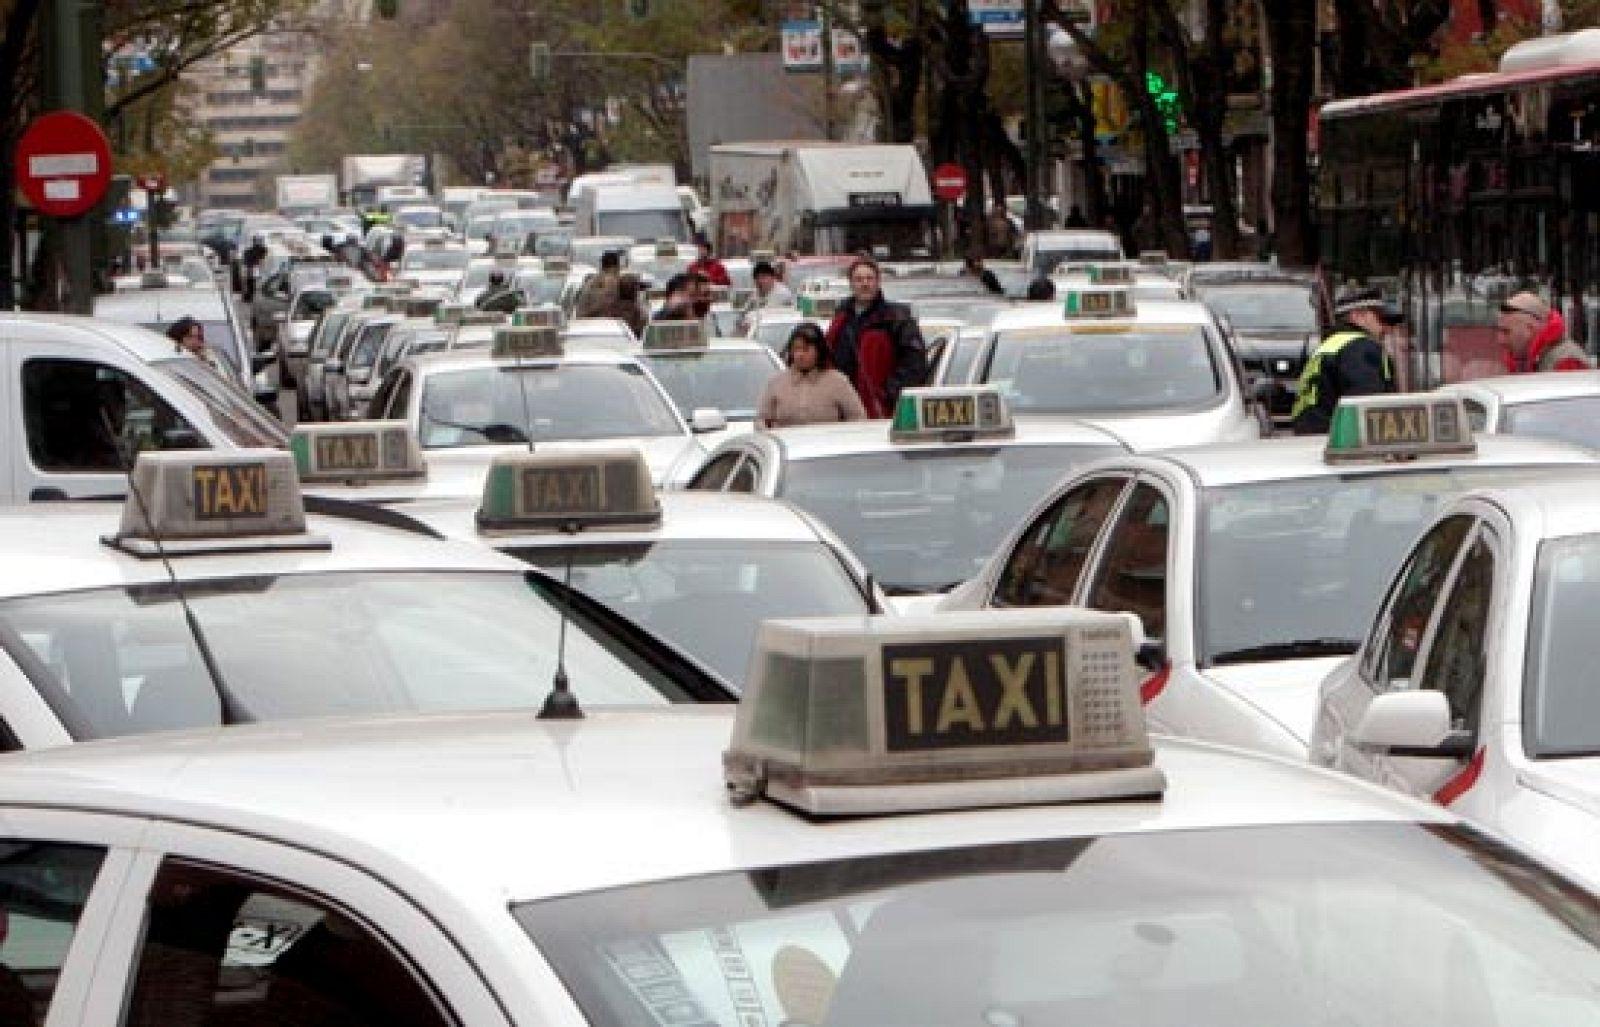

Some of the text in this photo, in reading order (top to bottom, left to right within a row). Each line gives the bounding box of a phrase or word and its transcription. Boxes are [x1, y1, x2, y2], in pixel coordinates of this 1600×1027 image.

[927, 399, 974, 425] TAXI
[1369, 411, 1426, 441] TAXI
[320, 438, 377, 468] TAXI
[195, 465, 267, 513] TAXI
[528, 472, 597, 508] TAXI
[892, 651, 1060, 736] TAXI
